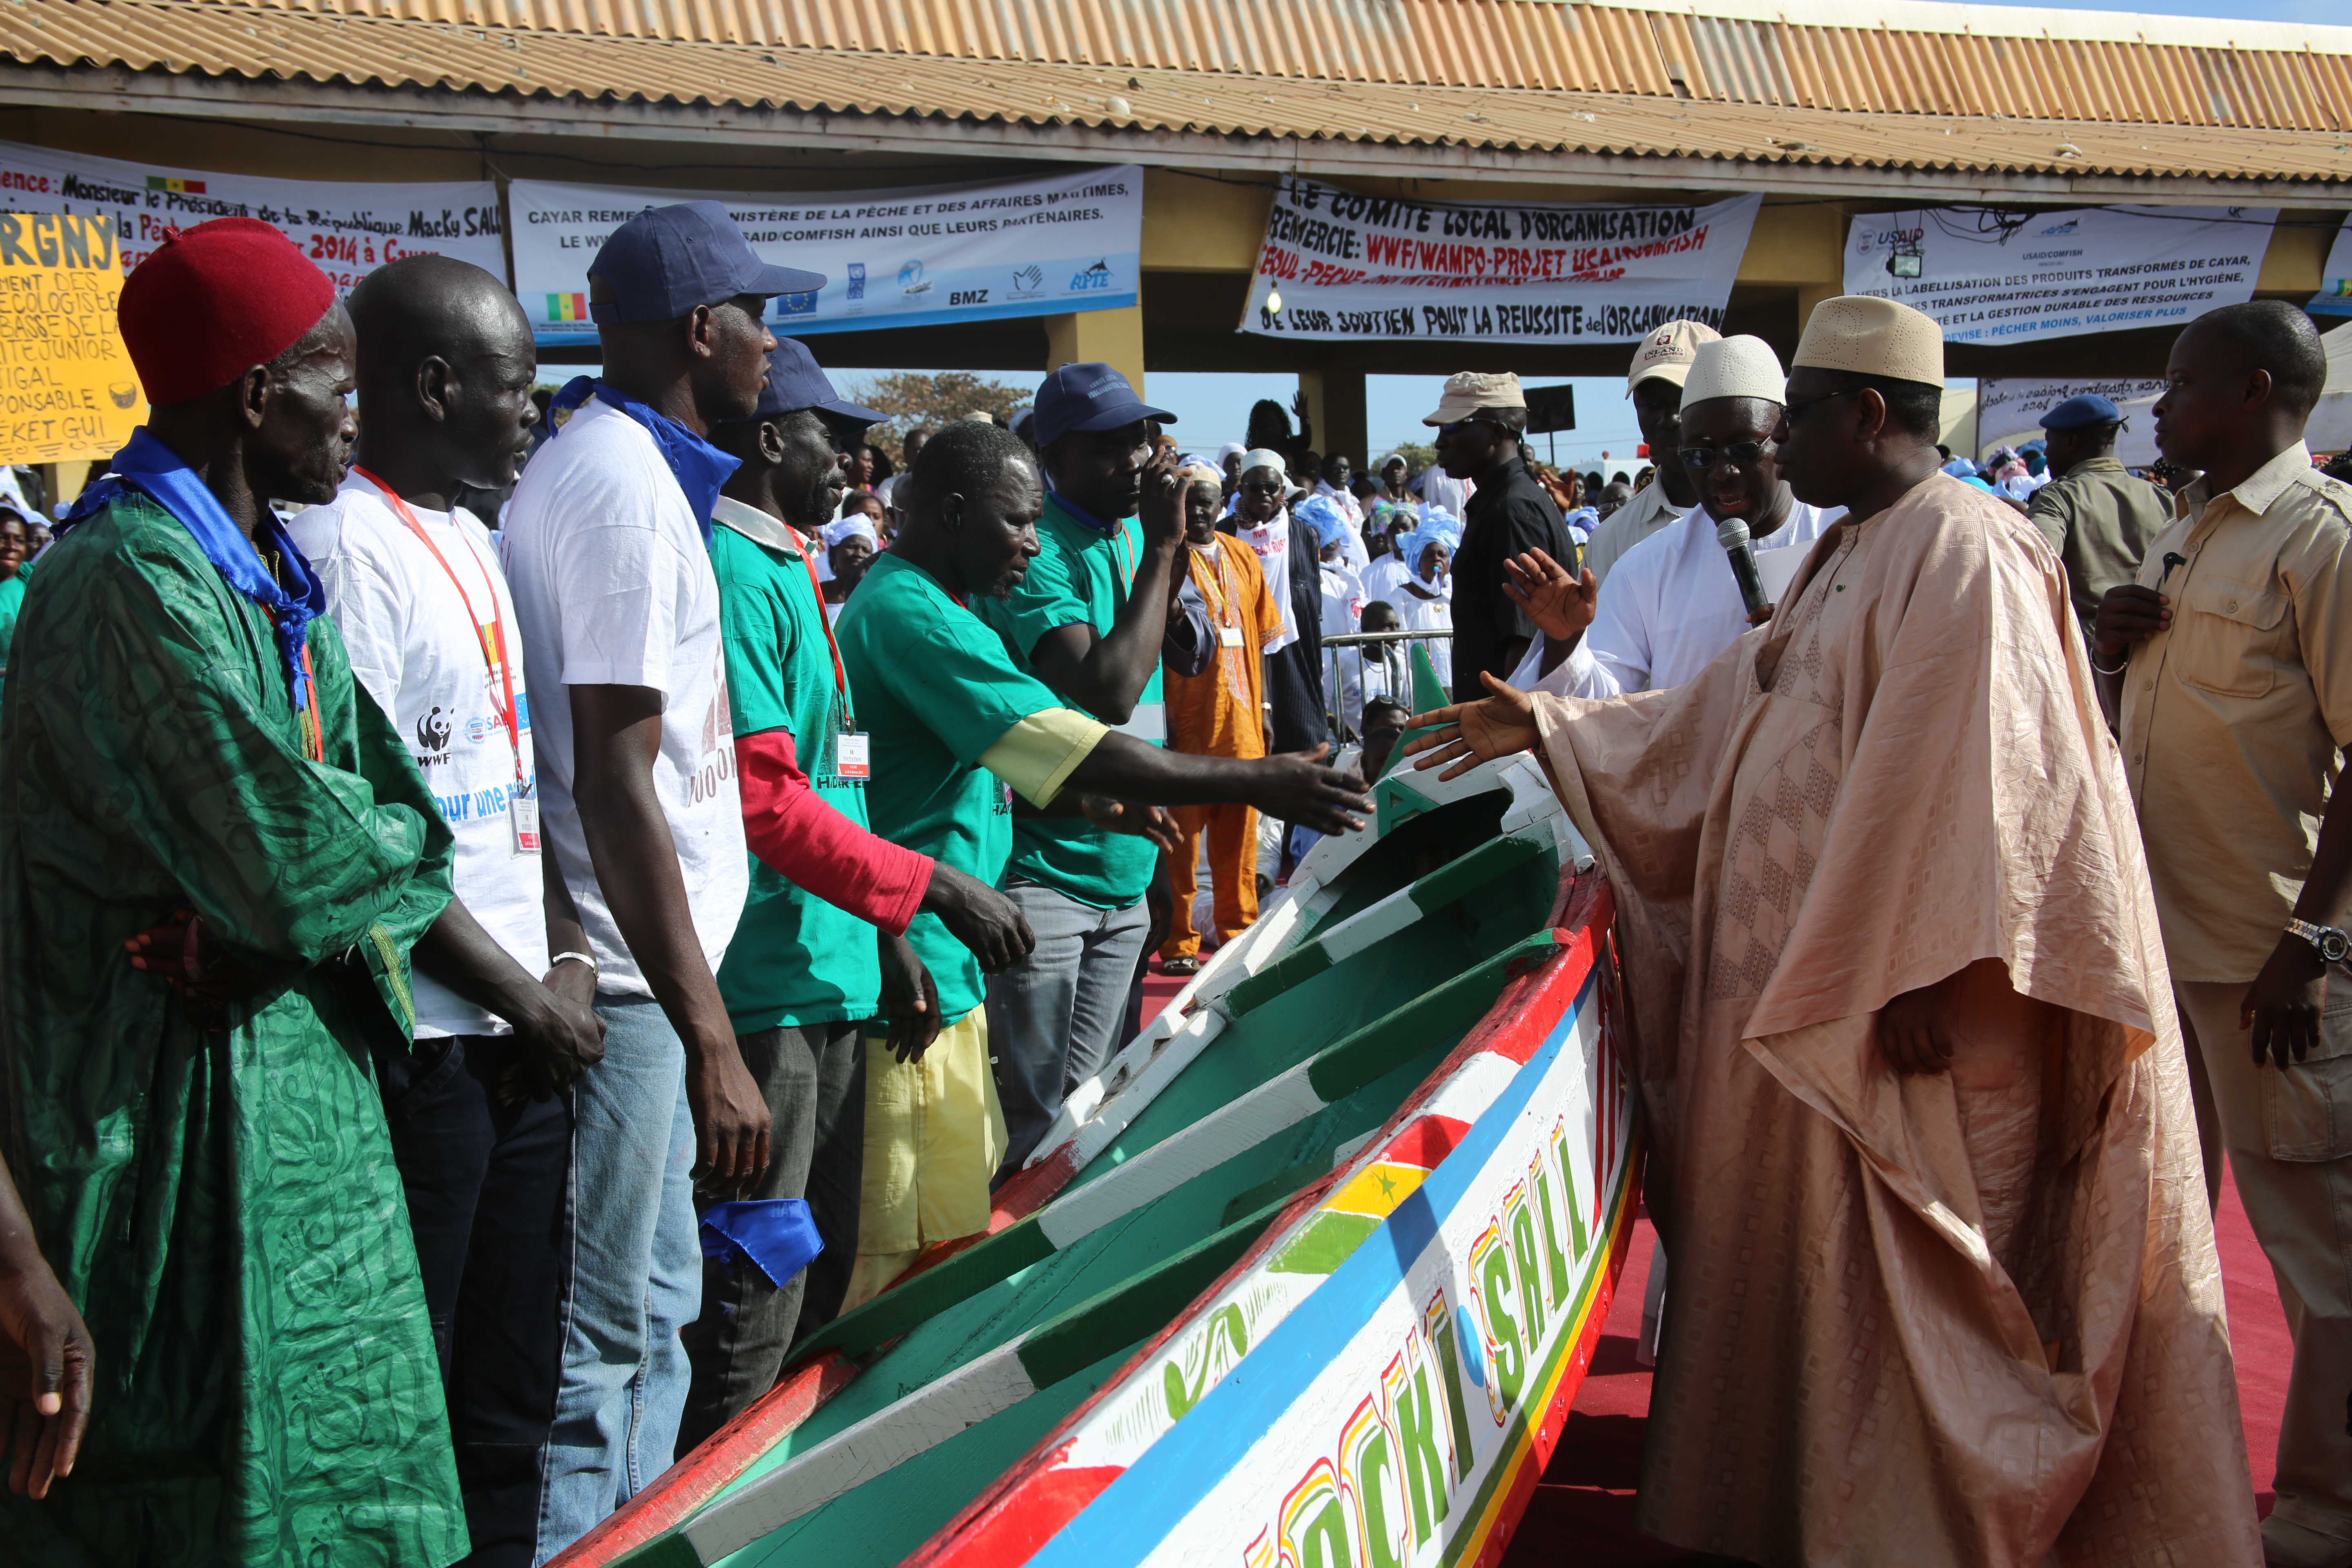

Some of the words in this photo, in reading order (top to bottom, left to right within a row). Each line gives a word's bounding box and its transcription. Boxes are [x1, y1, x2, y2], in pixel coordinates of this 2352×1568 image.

[61, 174, 140, 205] Monsieur
[145, 189, 160, 208] le
[258, 205, 281, 223] de
[464, 207, 501, 237] SALL
[528, 211, 583, 223] CAYAR
[730, 208, 800, 222] NISTÈRE
[805, 210, 826, 220] DE
[831, 209, 851, 219] LA
[857, 205, 908, 218] PÊCHE
[913, 204, 933, 215] ET
[937, 201, 966, 213] DES
[971, 194, 1042, 210] AFFAIRES
[1331, 192, 1433, 232] COMITE
[1443, 209, 1511, 240] LOCAL
[1519, 208, 1695, 242] D'ORGANISATION
[0, 214, 113, 270] RGNY
[561, 236, 580, 248] LE
[860, 226, 902, 238] AINSI
[908, 223, 941, 236] QUE
[947, 220, 997, 233] LEURS
[1270, 204, 1361, 259] REMERCIE:
[310, 234, 358, 265] 2014
[364, 236, 375, 263] à
[2022, 249, 2082, 260] USAID/COMFISH
[0, 274, 42, 292] MENT
[54, 272, 98, 292] DES
[1892, 287, 1903, 296] LA
[1906, 277, 2000, 294] LABELLISATION
[2005, 275, 2028, 286] DES
[2032, 270, 2092, 283] PRODUITS
[2097, 259, 2185, 278] TRANSFORMÉS
[2189, 259, 2206, 269] DE
[2209, 255, 2251, 267] CAYAR,
[1931, 289, 2059, 309] TRANSFORMATRICES
[2062, 282, 2140, 296] S'ENGAGENT
[2143, 278, 2176, 290] POUR
[2180, 272, 2244, 287] L'HYGIÈNE,
[949, 289, 988, 305] BMZ
[1953, 313, 1967, 323] ET
[1970, 310, 1984, 321] LA
[1988, 305, 2041, 319] GESTION
[2044, 299, 2103, 312] DURABLE
[2104, 297, 2127, 307] DES
[2132, 291, 2214, 305] RESSOURCES
[1289, 308, 1333, 331] LEUR
[1337, 306, 1415, 335] SOUTIEN
[1473, 305, 1492, 334] LA
[1496, 304, 1583, 335] REUSSITE
[1944, 330, 1982, 343] DEVISE
[1991, 321, 2037, 336] PÊCHER
[2041, 317, 2081, 330] MOINS,
[2086, 310, 2152, 324] VALORISER
[2156, 307, 2187, 317] PLUS
[1644, 347, 1683, 358] INLAND
[62, 416, 105, 440] GUI
[417, 752, 451, 767] WWF
[474, 787, 506, 817] une
[1468, 1114, 1588, 1428] SALL
